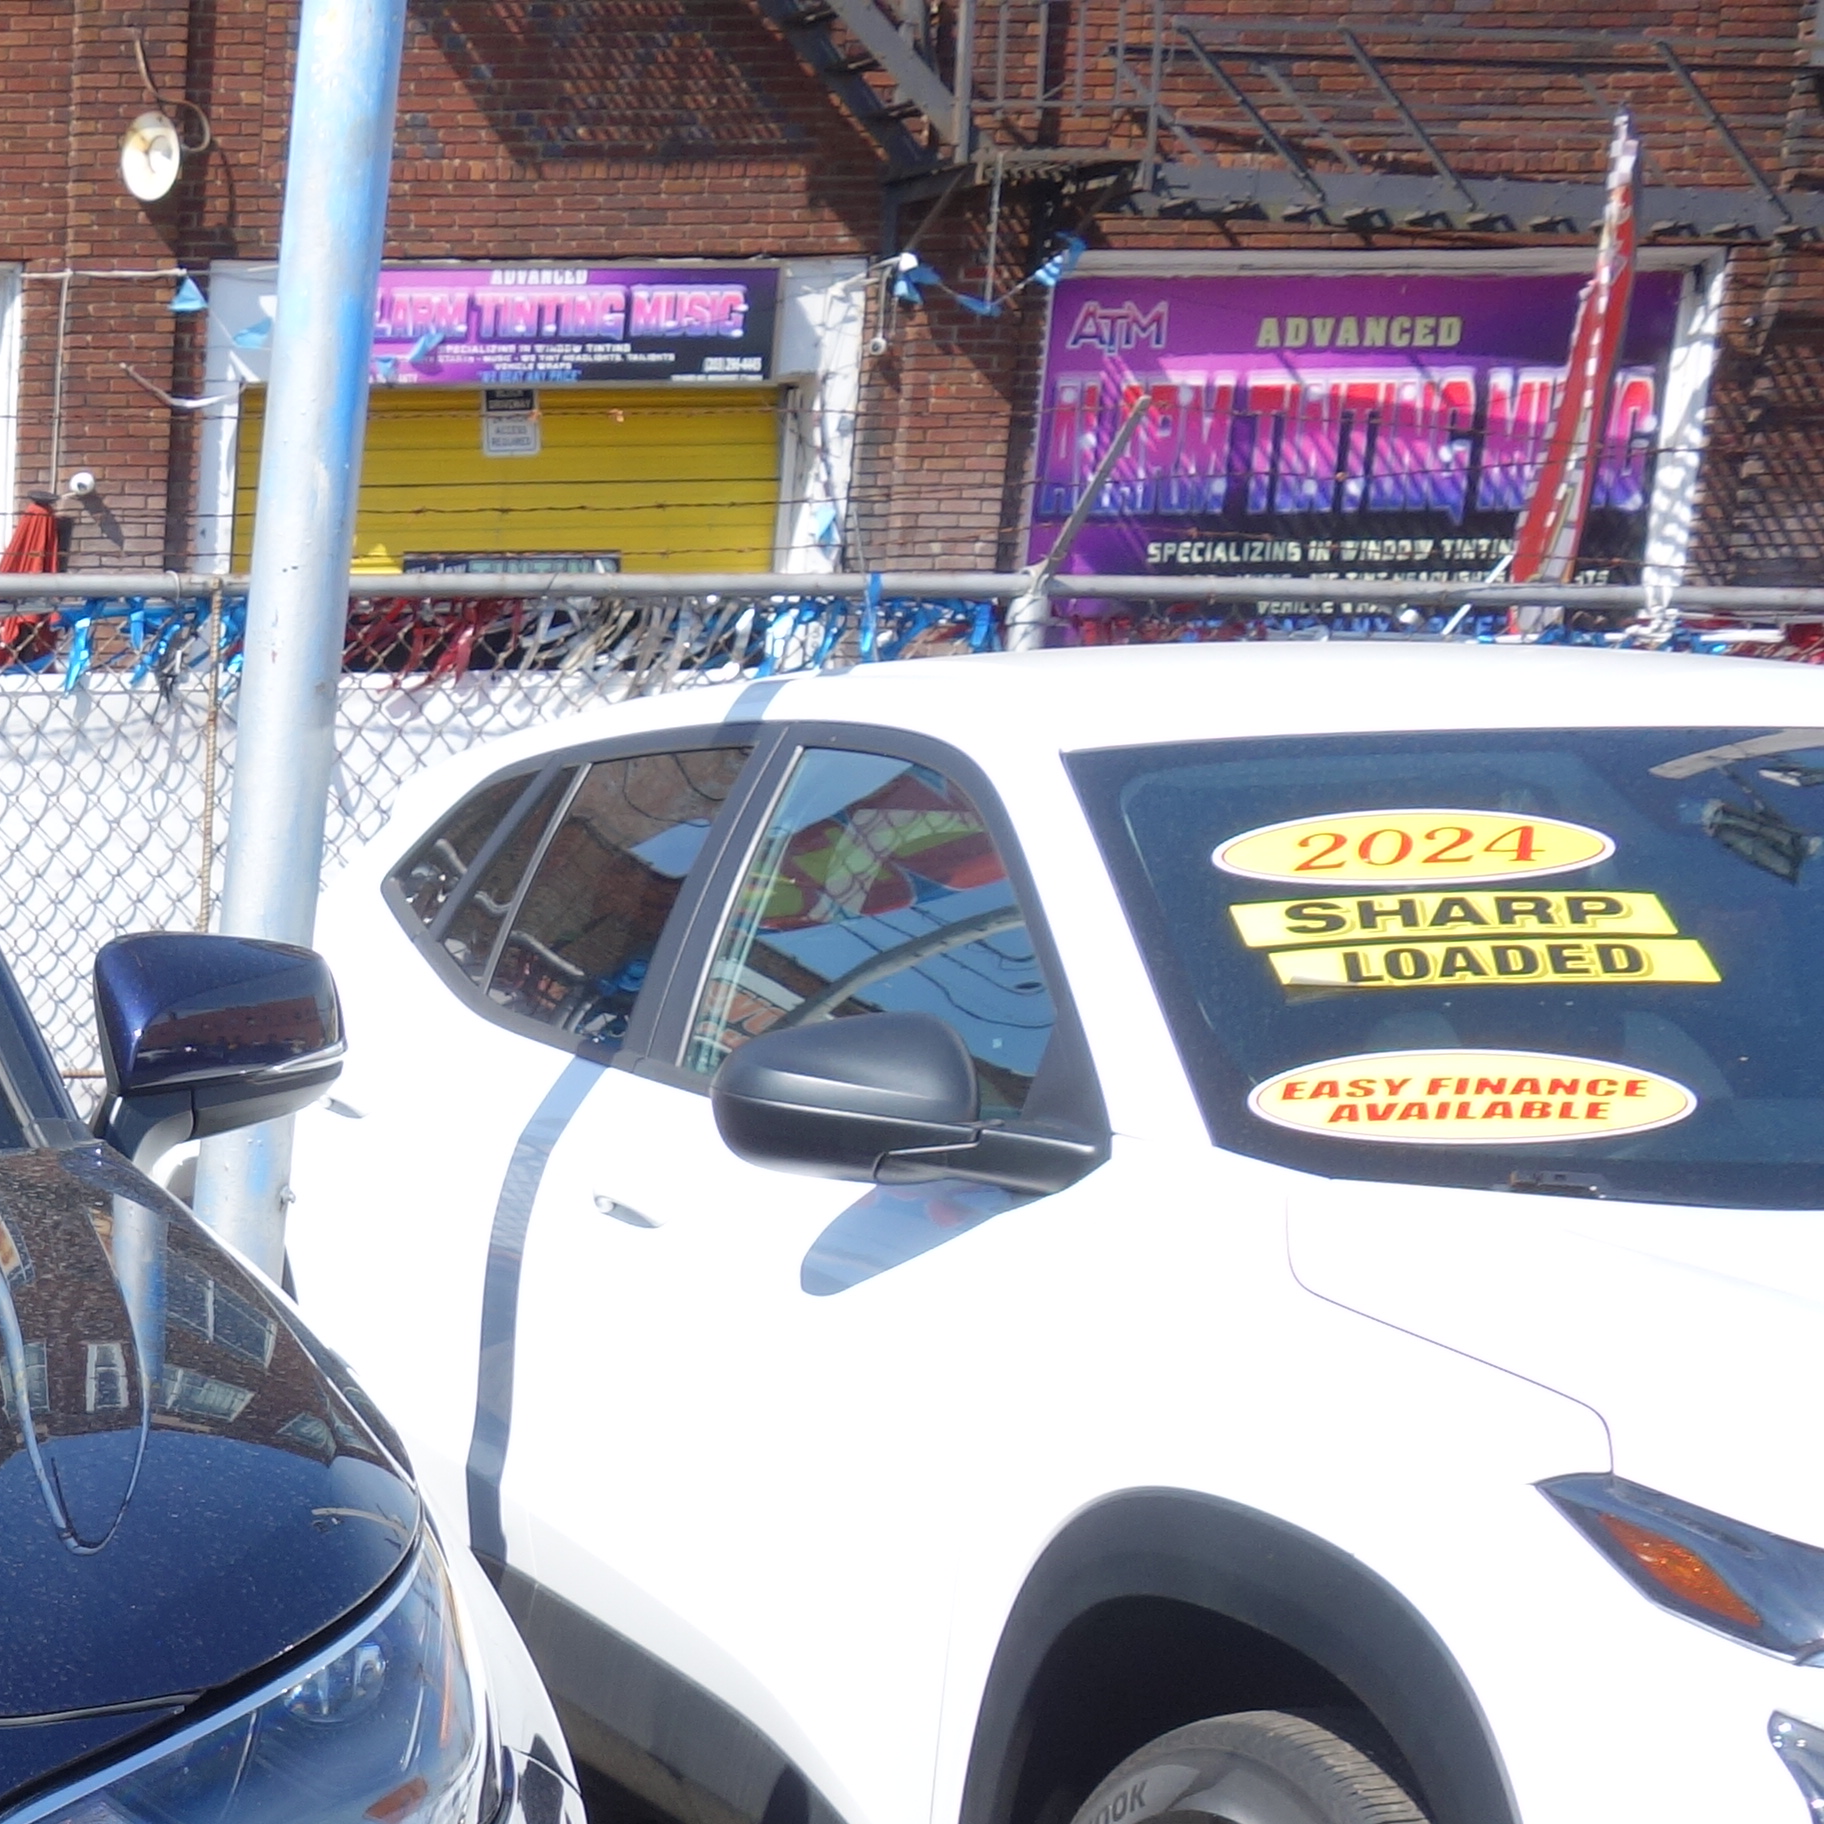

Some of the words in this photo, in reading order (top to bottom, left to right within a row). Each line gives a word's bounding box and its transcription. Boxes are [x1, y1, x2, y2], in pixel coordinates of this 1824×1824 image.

[372, 286, 469, 338] LARM
[475, 285, 625, 341] TINTING
[630, 284, 749, 338] MUSIC
[1067, 301, 1168, 355] ATM
[1256, 316, 1463, 348] ADVANCED
[1147, 540, 1301, 562] SPECIALIZING
[1308, 540, 1331, 562] IN
[1339, 539, 1435, 561] WINDOW
[1440, 539, 1514, 560] TINTIN
[1294, 825, 1545, 872] 2024
[1284, 895, 1628, 935] SHARP
[1342, 943, 1649, 982] LOADED
[1281, 1077, 1412, 1101] EASY
[1425, 1075, 1649, 1098] FINANCE
[1328, 1101, 1612, 1123] AVAILABLE
